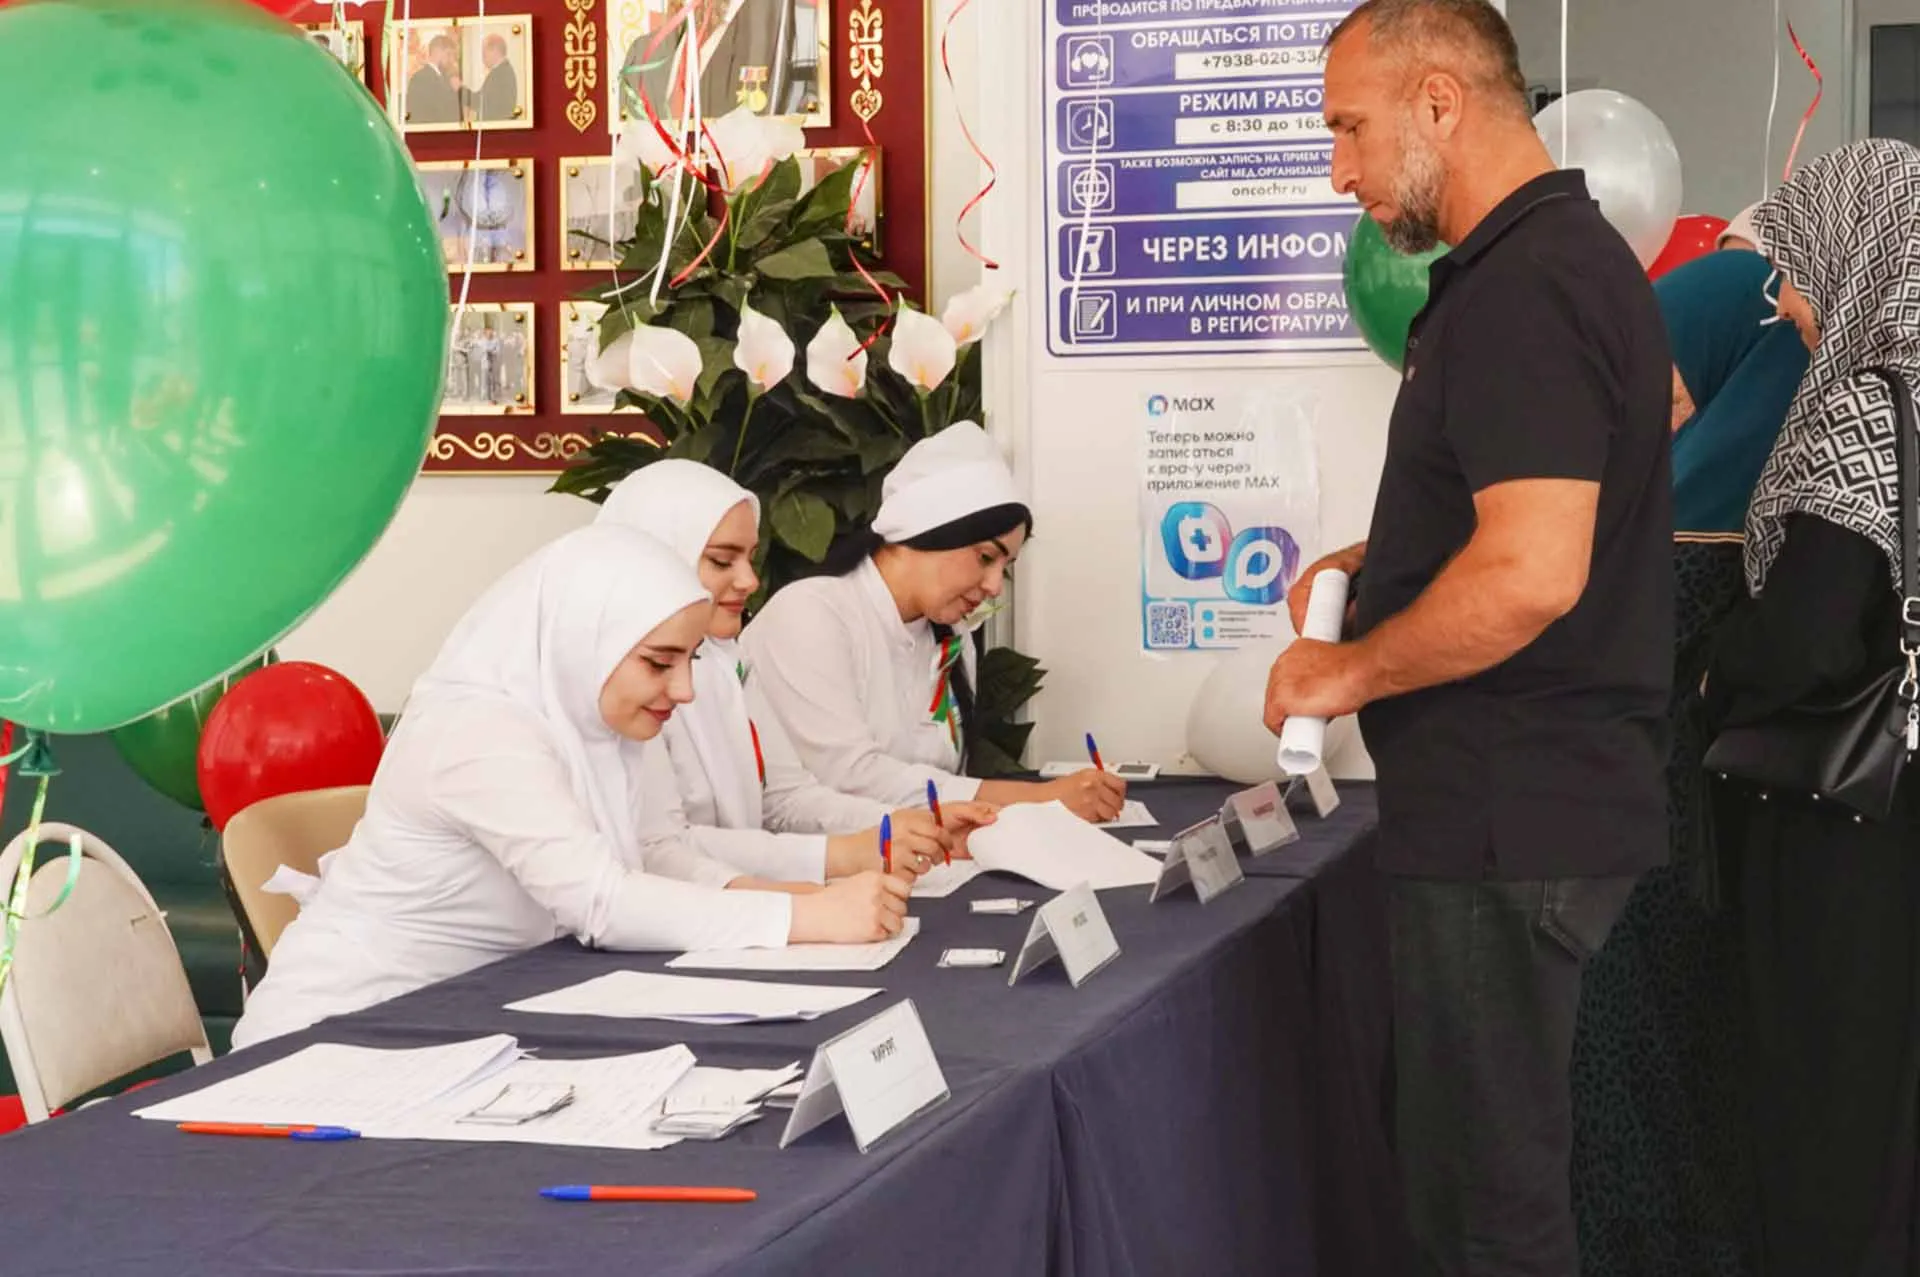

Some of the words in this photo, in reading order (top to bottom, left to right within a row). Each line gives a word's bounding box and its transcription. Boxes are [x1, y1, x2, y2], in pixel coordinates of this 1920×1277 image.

[1072, 1, 1167, 17] ПРОВОДИТСЯ
[1131, 26, 1260, 48] ОБРАЩАТЬСЯ
[1266, 24, 1296, 41] ПО
[1301, 22, 1335, 39] ТЕЛ
[1179, 91, 1257, 112] РЕЖИМ
[1264, 88, 1325, 108] РАБО
[1211, 121, 1220, 133] с
[1226, 118, 1262, 132] 8:30
[1267, 120, 1288, 133] до
[1296, 117, 1328, 130] 16:
[1120, 158, 1153, 169] ТАКЖЕ
[1156, 155, 1216, 168] ВОЗМОЖНА
[1219, 153, 1262, 165] ЗАПИСЬ
[1265, 153, 1281, 163] НА
[1283, 151, 1320, 162] ПРИЕМ
[1201, 168, 1229, 179] САЙТ
[1231, 183, 1307, 197] oncochrru
[1143, 235, 1228, 262] ЧЕРЕЗ
[1237, 231, 1347, 260] ИНФОМ
[1126, 296, 1140, 314] И
[1146, 295, 1184, 314] ПРИ
[1190, 293, 1280, 312] ЛИЧНОМ
[1286, 292, 1347, 310] ОБРА
[1190, 317, 1202, 334] В
[1208, 313, 1349, 334] РЕГИСТРАТУРУ
[1147, 430, 1201, 445] Теперь
[1204, 431, 1255, 442] можно
[1148, 447, 1234, 459] записаться
[1208, 462, 1252, 476] через
[1147, 479, 1241, 493] приложение
